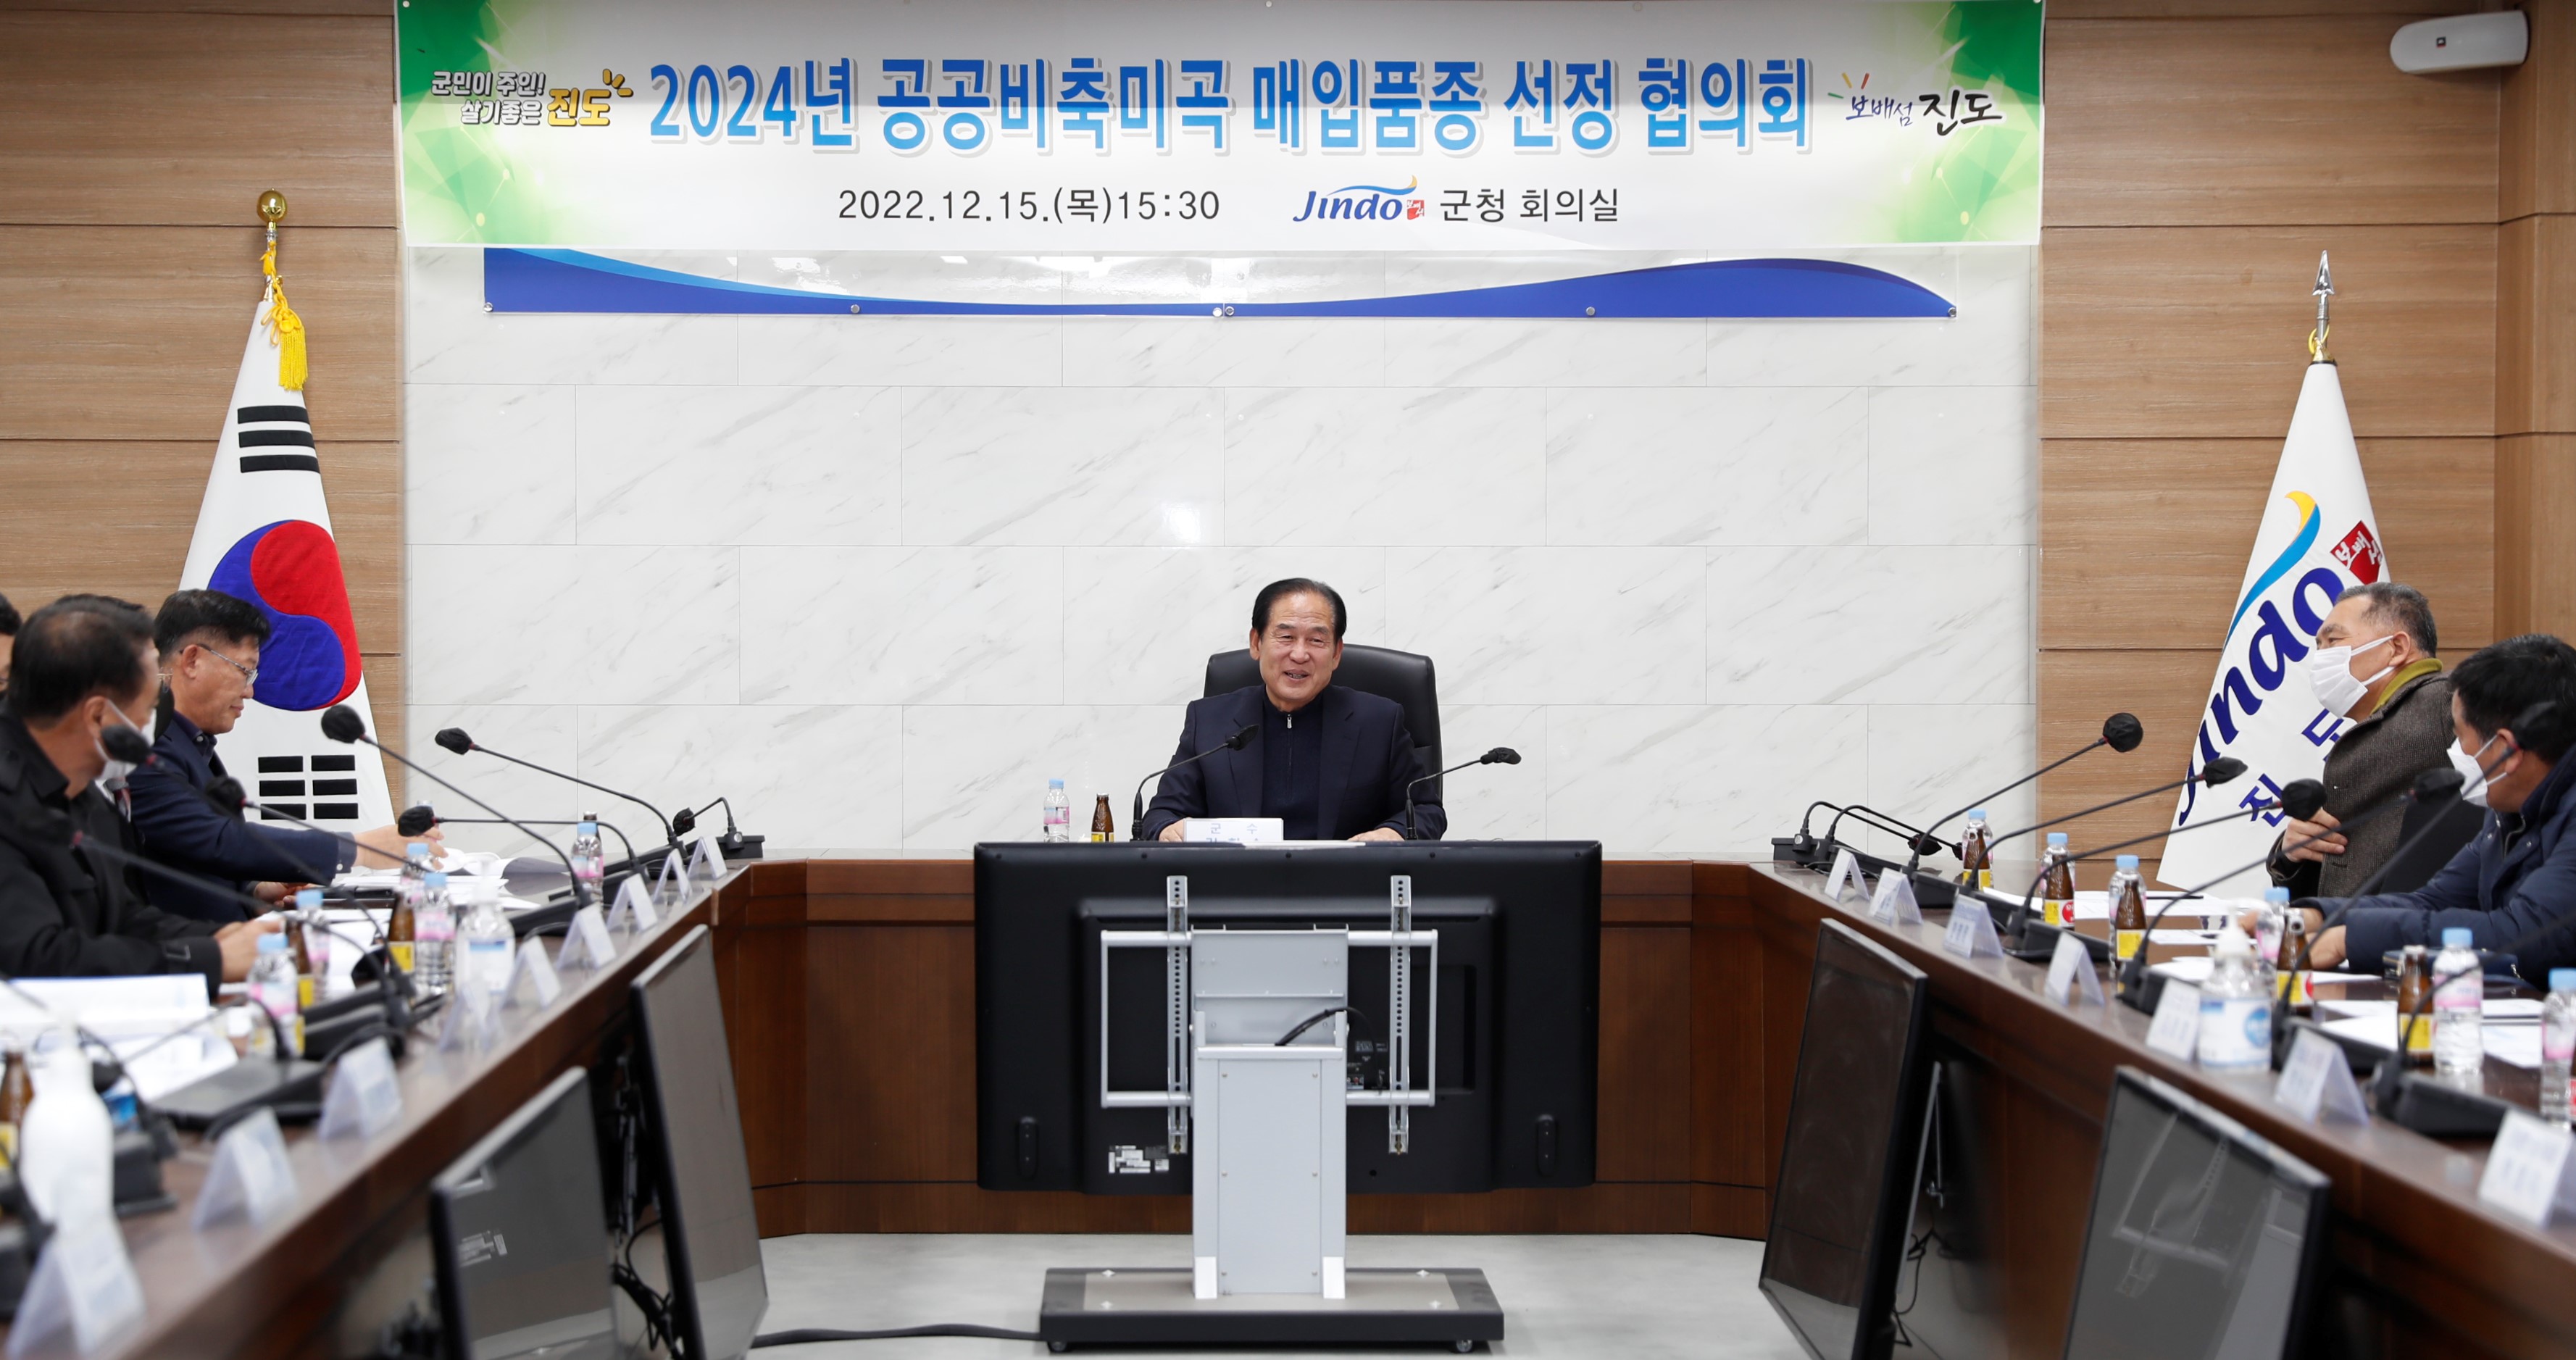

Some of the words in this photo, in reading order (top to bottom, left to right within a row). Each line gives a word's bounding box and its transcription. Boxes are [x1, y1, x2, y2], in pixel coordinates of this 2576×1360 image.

[431, 70, 493, 96] 군민이
[496, 70, 546, 96] 주인!
[461, 99, 543, 125] 살기좋은
[546, 87, 612, 127] 진도
[649, 57, 855, 147] 2024년
[877, 57, 1230, 150] 공공비축미곡
[1252, 58, 1484, 150] 매입품종
[1503, 59, 1614, 150] 선정
[1638, 57, 1807, 149] 협의회
[1846, 95, 1914, 127] 보배섬
[1918, 88, 2003, 136] 진도
[838, 187, 1220, 224] 2022.12.15.(목)15:30
[1293, 188, 1403, 222] Jindo
[1439, 188, 1505, 222] 군청
[1520, 188, 1618, 222] 회의실
